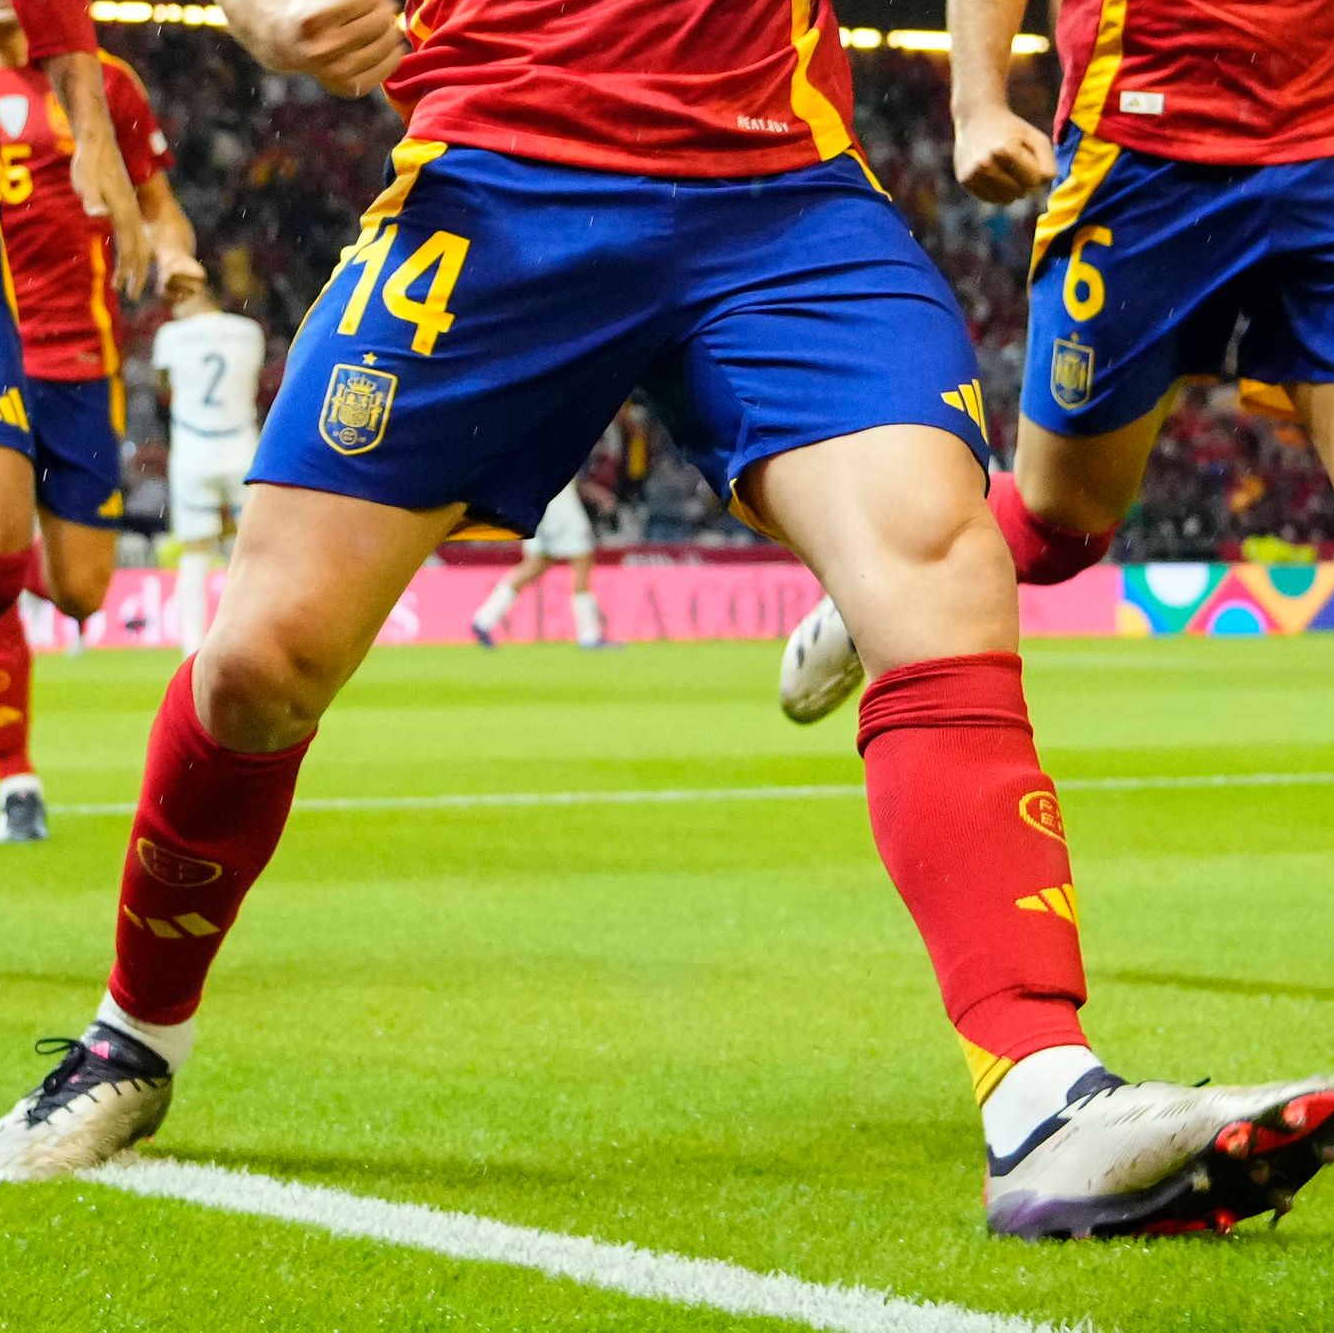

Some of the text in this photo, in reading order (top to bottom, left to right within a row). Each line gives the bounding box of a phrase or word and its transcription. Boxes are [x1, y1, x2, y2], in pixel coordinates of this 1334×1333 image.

[335, 222, 471, 357] 14
[1062, 223, 1114, 323] 6
[201, 352, 228, 407] 2
